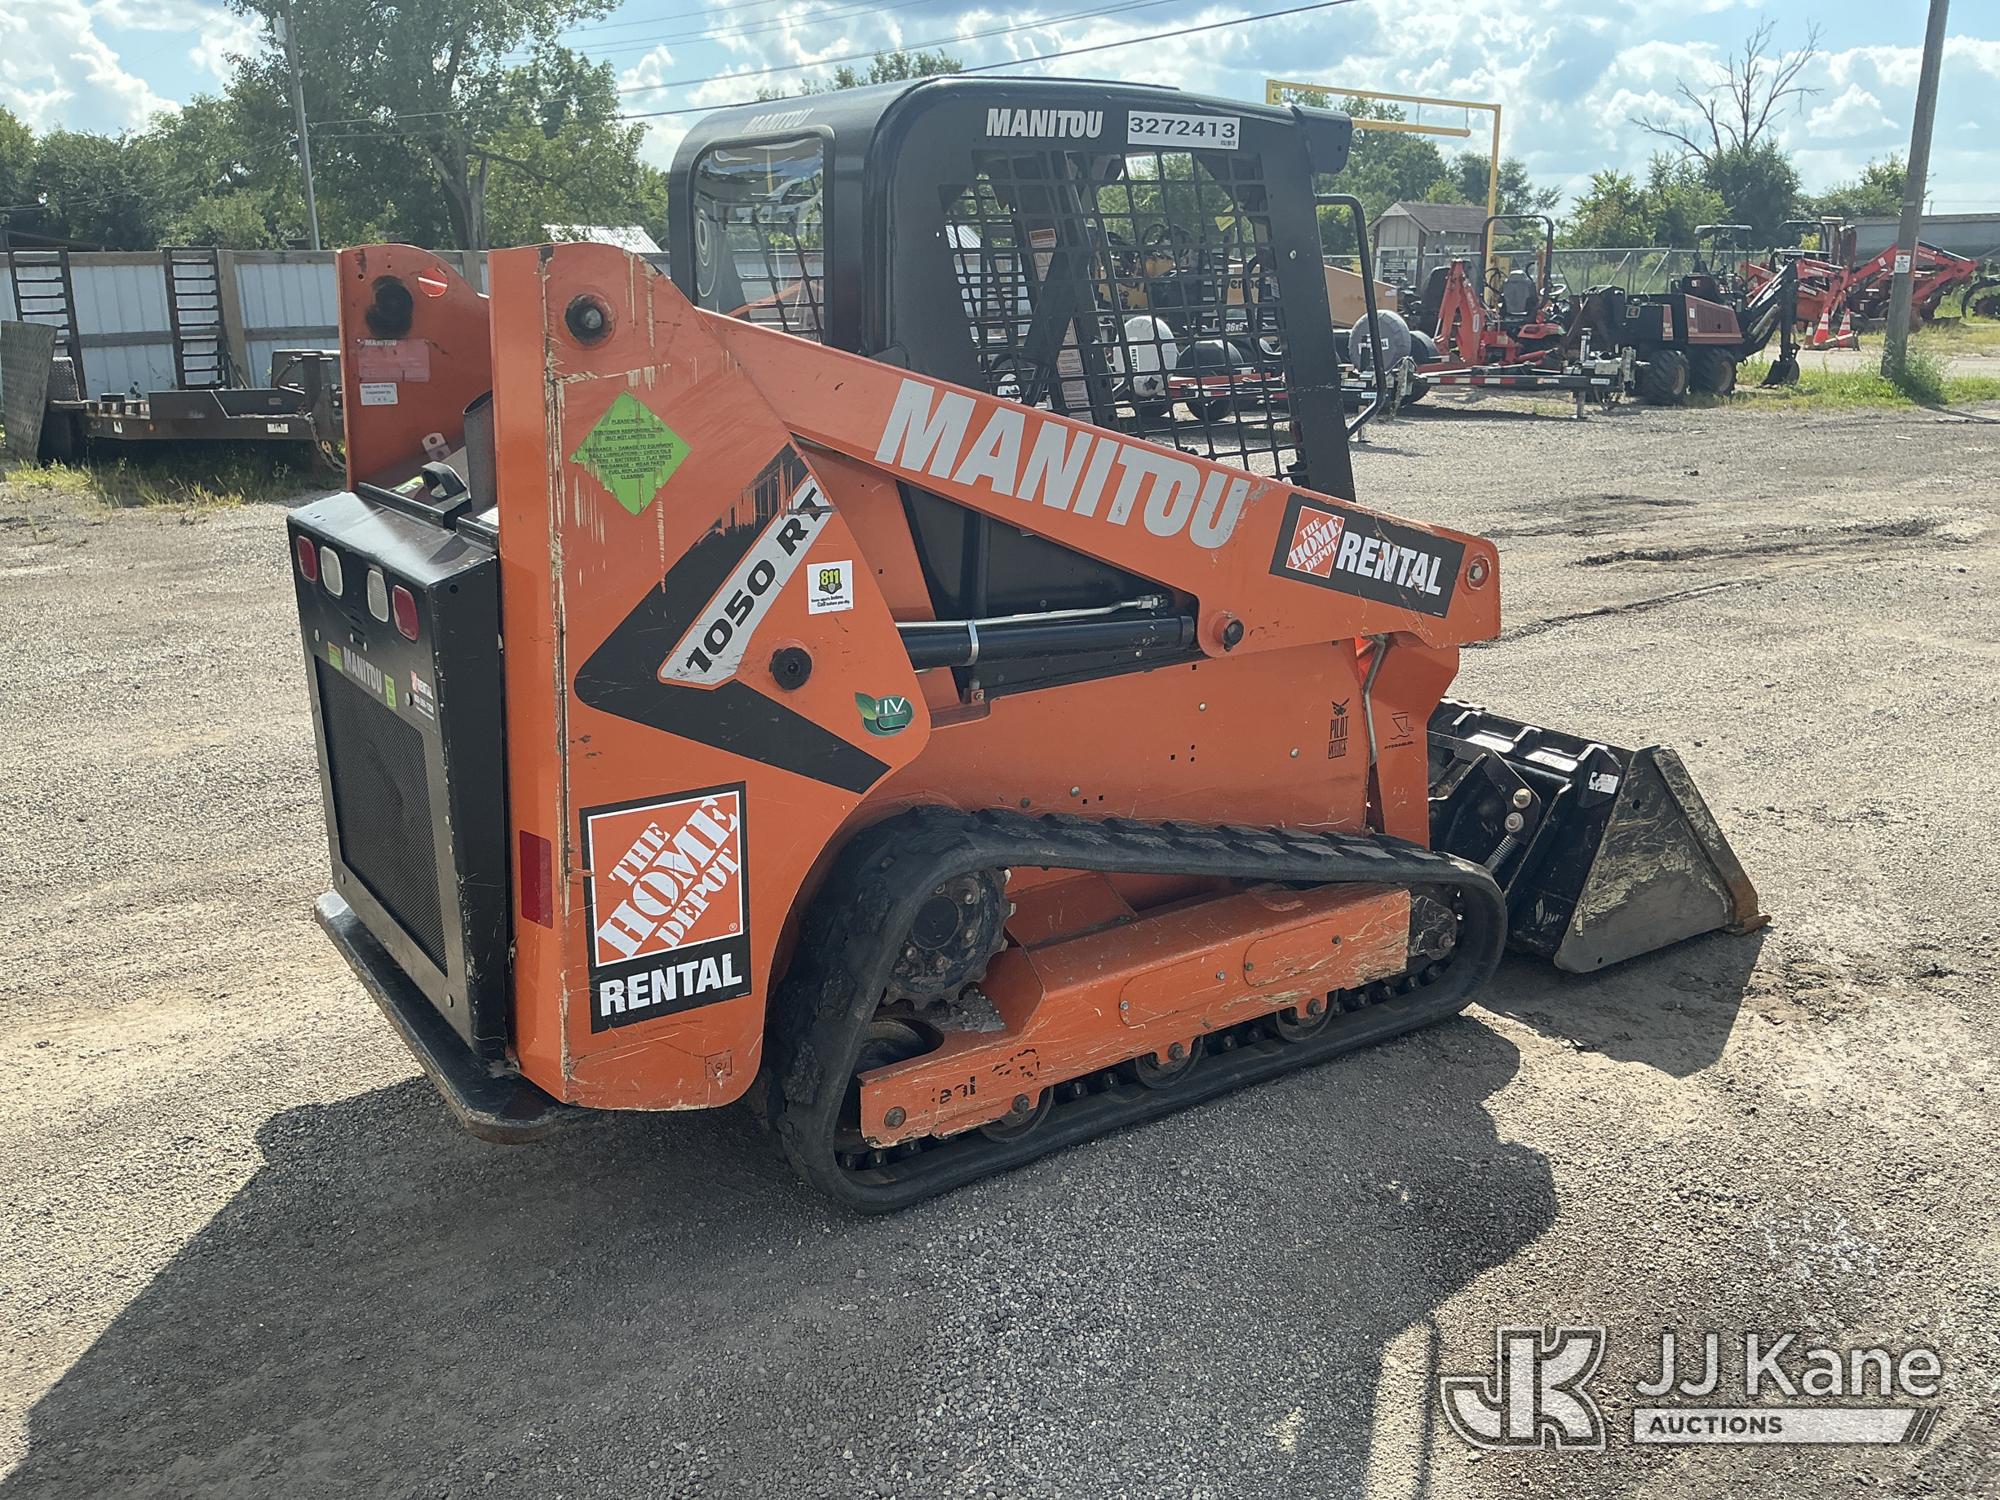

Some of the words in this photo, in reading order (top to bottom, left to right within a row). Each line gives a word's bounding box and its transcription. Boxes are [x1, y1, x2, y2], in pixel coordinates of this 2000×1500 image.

[986, 108, 1104, 139] MANITOU
[1130, 116, 1236, 139] 3272413
[874, 377, 1251, 549] MANITOU
[1288, 515, 1343, 569] HOME
[1300, 517, 1321, 540] THE
[685, 559, 776, 673] 1050
[776, 487, 826, 556] RT
[820, 568, 840, 586] 811
[1304, 540, 1338, 573] DEPOT
[1336, 531, 1442, 596] RENTAL
[343, 646, 382, 694] MANITOU
[1330, 716, 1348, 740] PILOT
[596, 797, 738, 959] HOME
[608, 822, 671, 887] THE
[655, 847, 739, 949] DEPOT
[599, 952, 743, 1018] RENTAL
